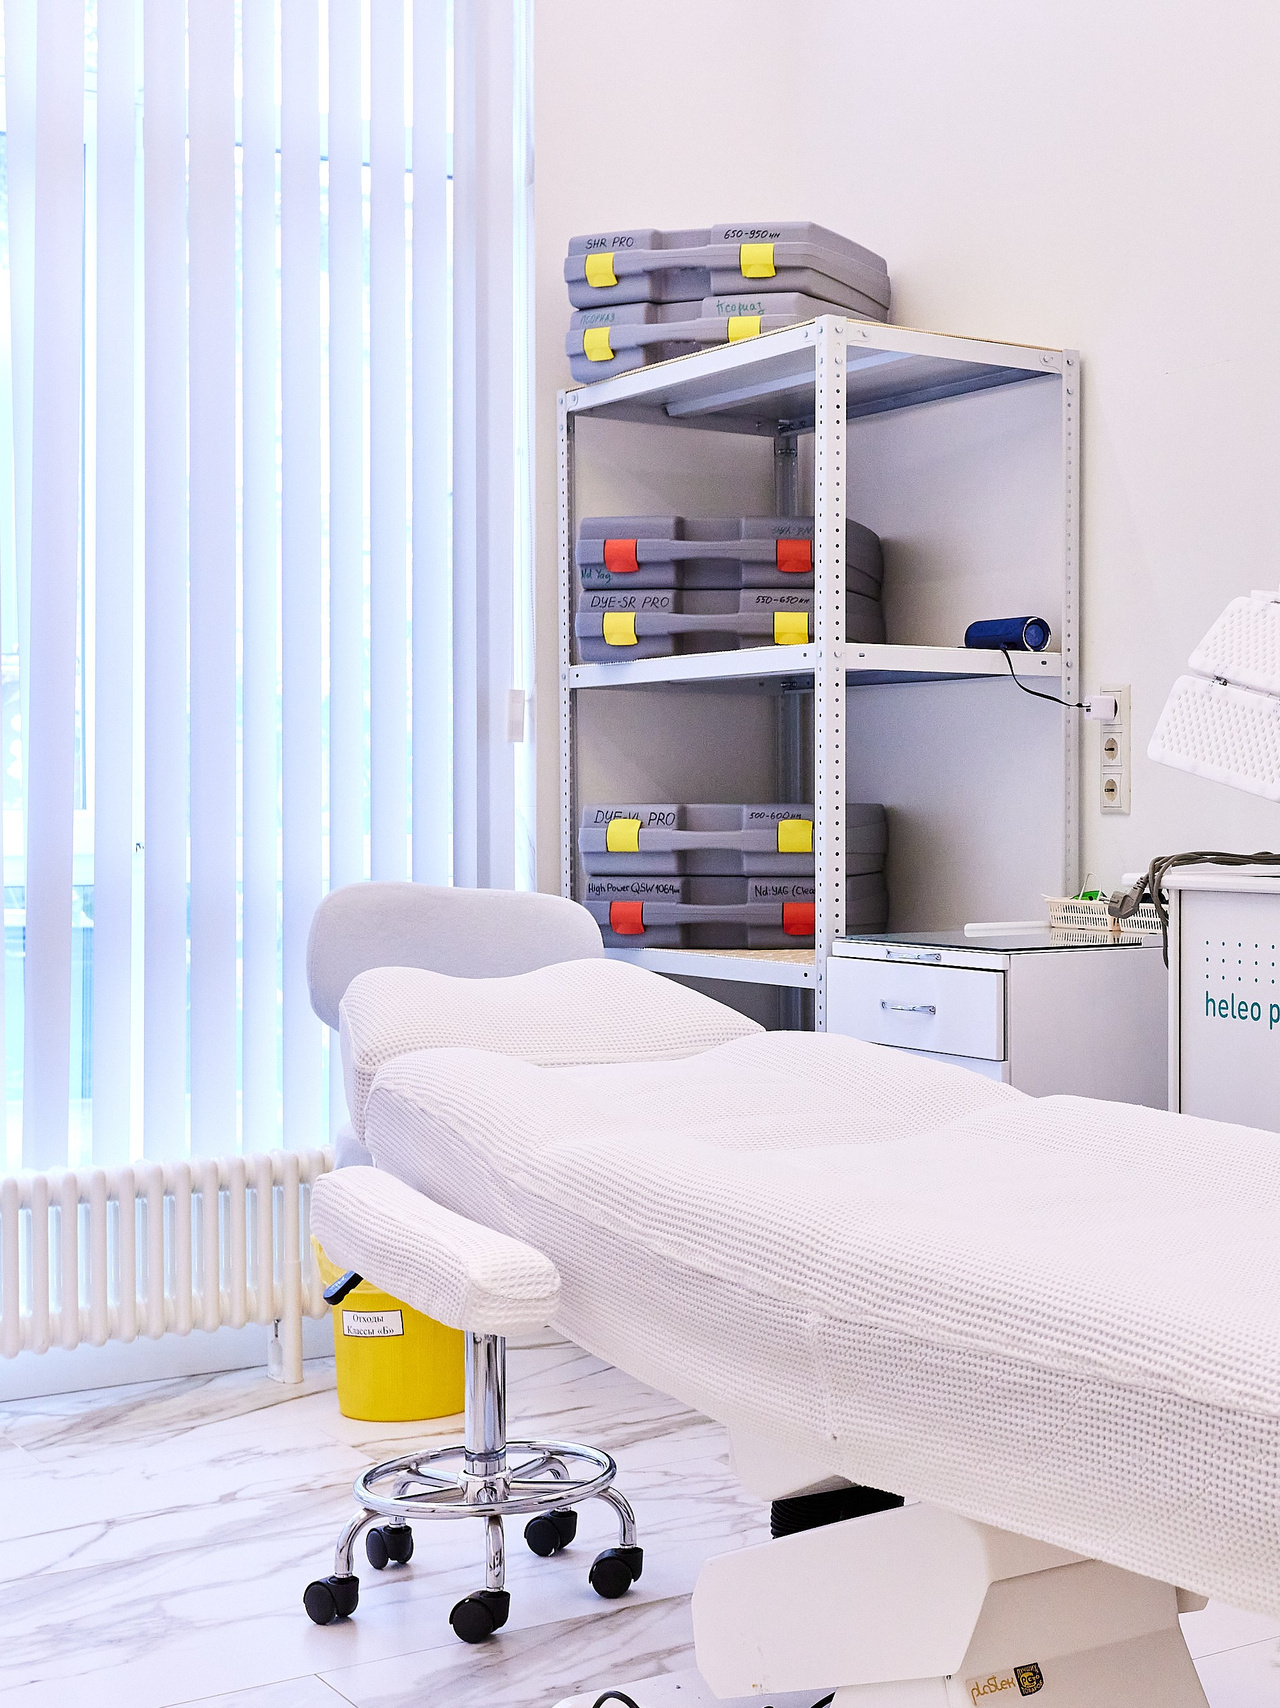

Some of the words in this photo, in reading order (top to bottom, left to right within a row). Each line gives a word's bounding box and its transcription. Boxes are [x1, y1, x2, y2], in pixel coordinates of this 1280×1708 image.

[585, 238, 607, 249] SHR
[612, 236, 634, 248] PRO
[641, 596, 670, 608] PRO
[648, 812, 676, 826] PRO
[588, 882, 606, 896] High
[606, 882, 630, 893] Power
[630, 881, 655, 894] QSW
[1205, 990, 1262, 1022] heleo
[352, 1314, 384, 1323] Отходы
[347, 1325, 375, 1335] Классы
